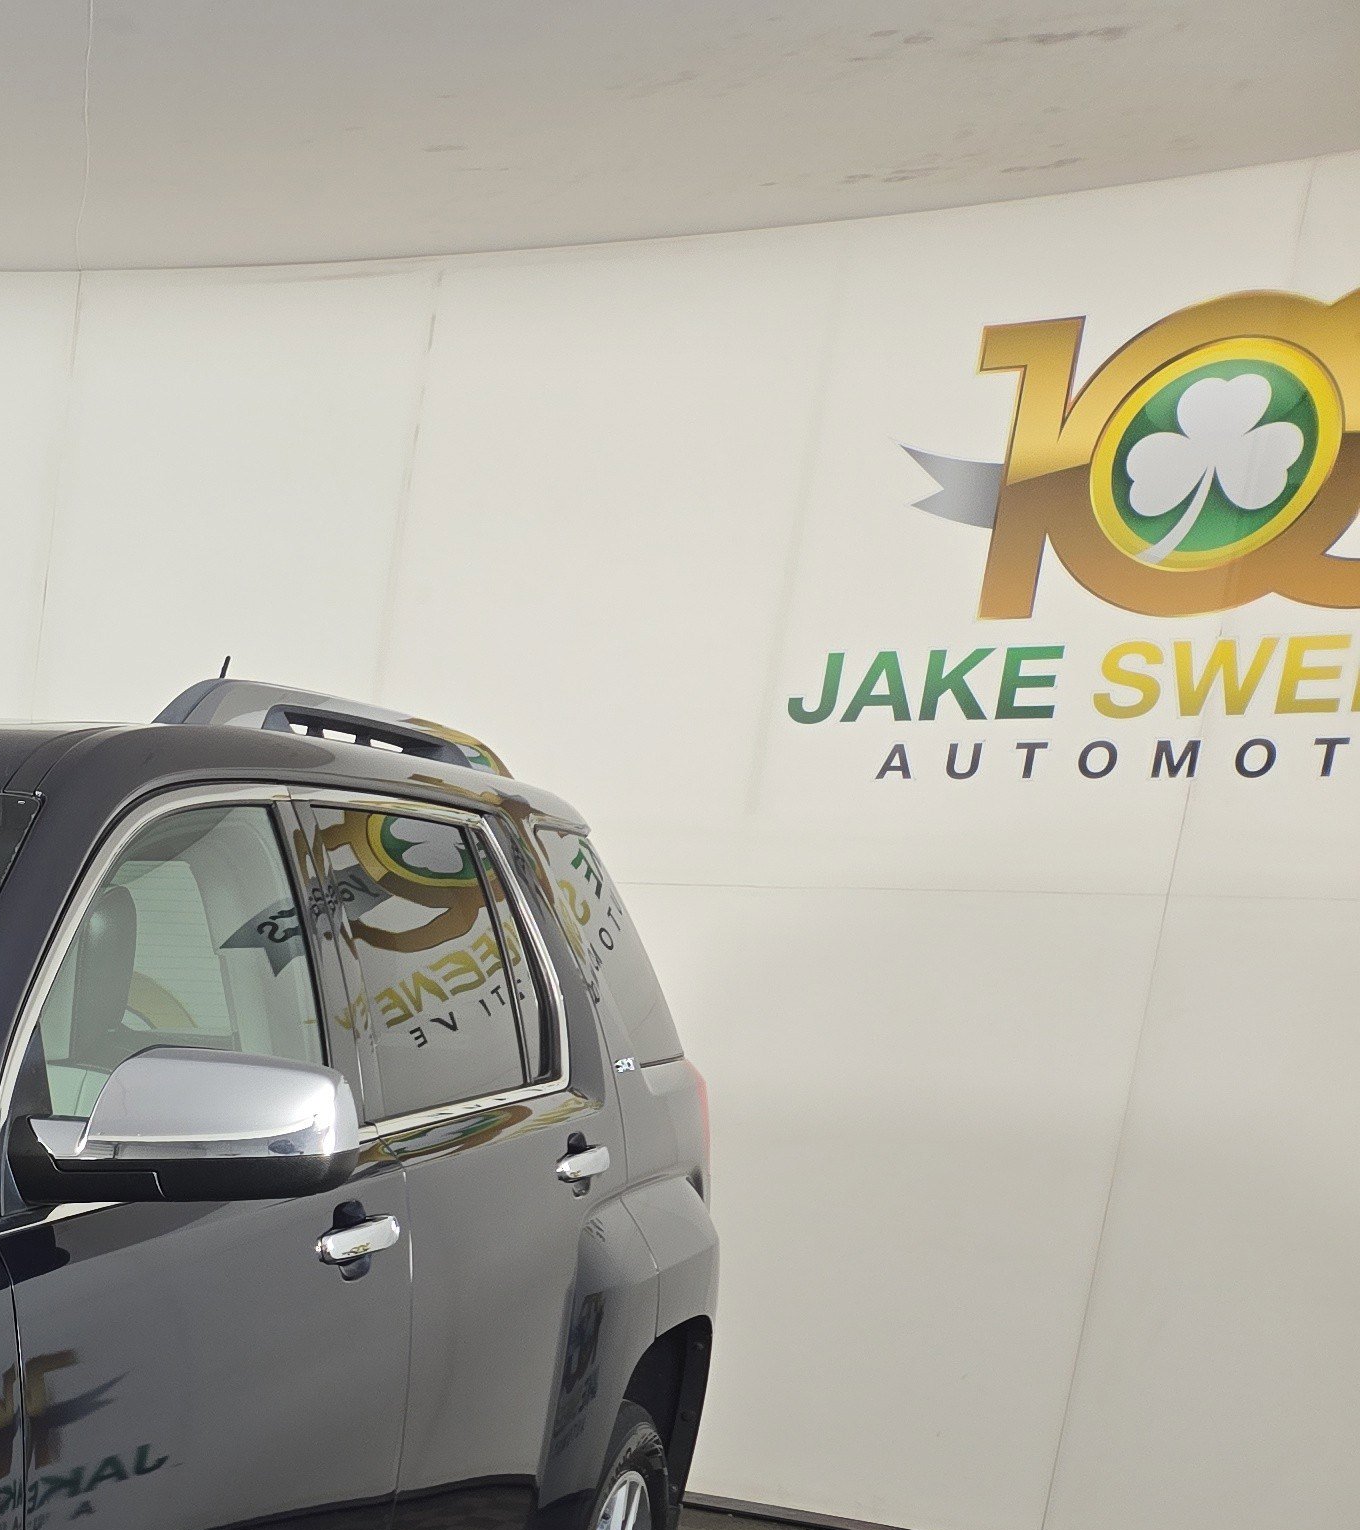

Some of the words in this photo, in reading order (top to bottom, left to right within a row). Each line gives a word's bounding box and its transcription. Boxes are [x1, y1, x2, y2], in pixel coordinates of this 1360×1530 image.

[979, 286, 1360, 619] 10
[787, 645, 1065, 725] JAKE
[1093, 634, 1360, 719] SWE
